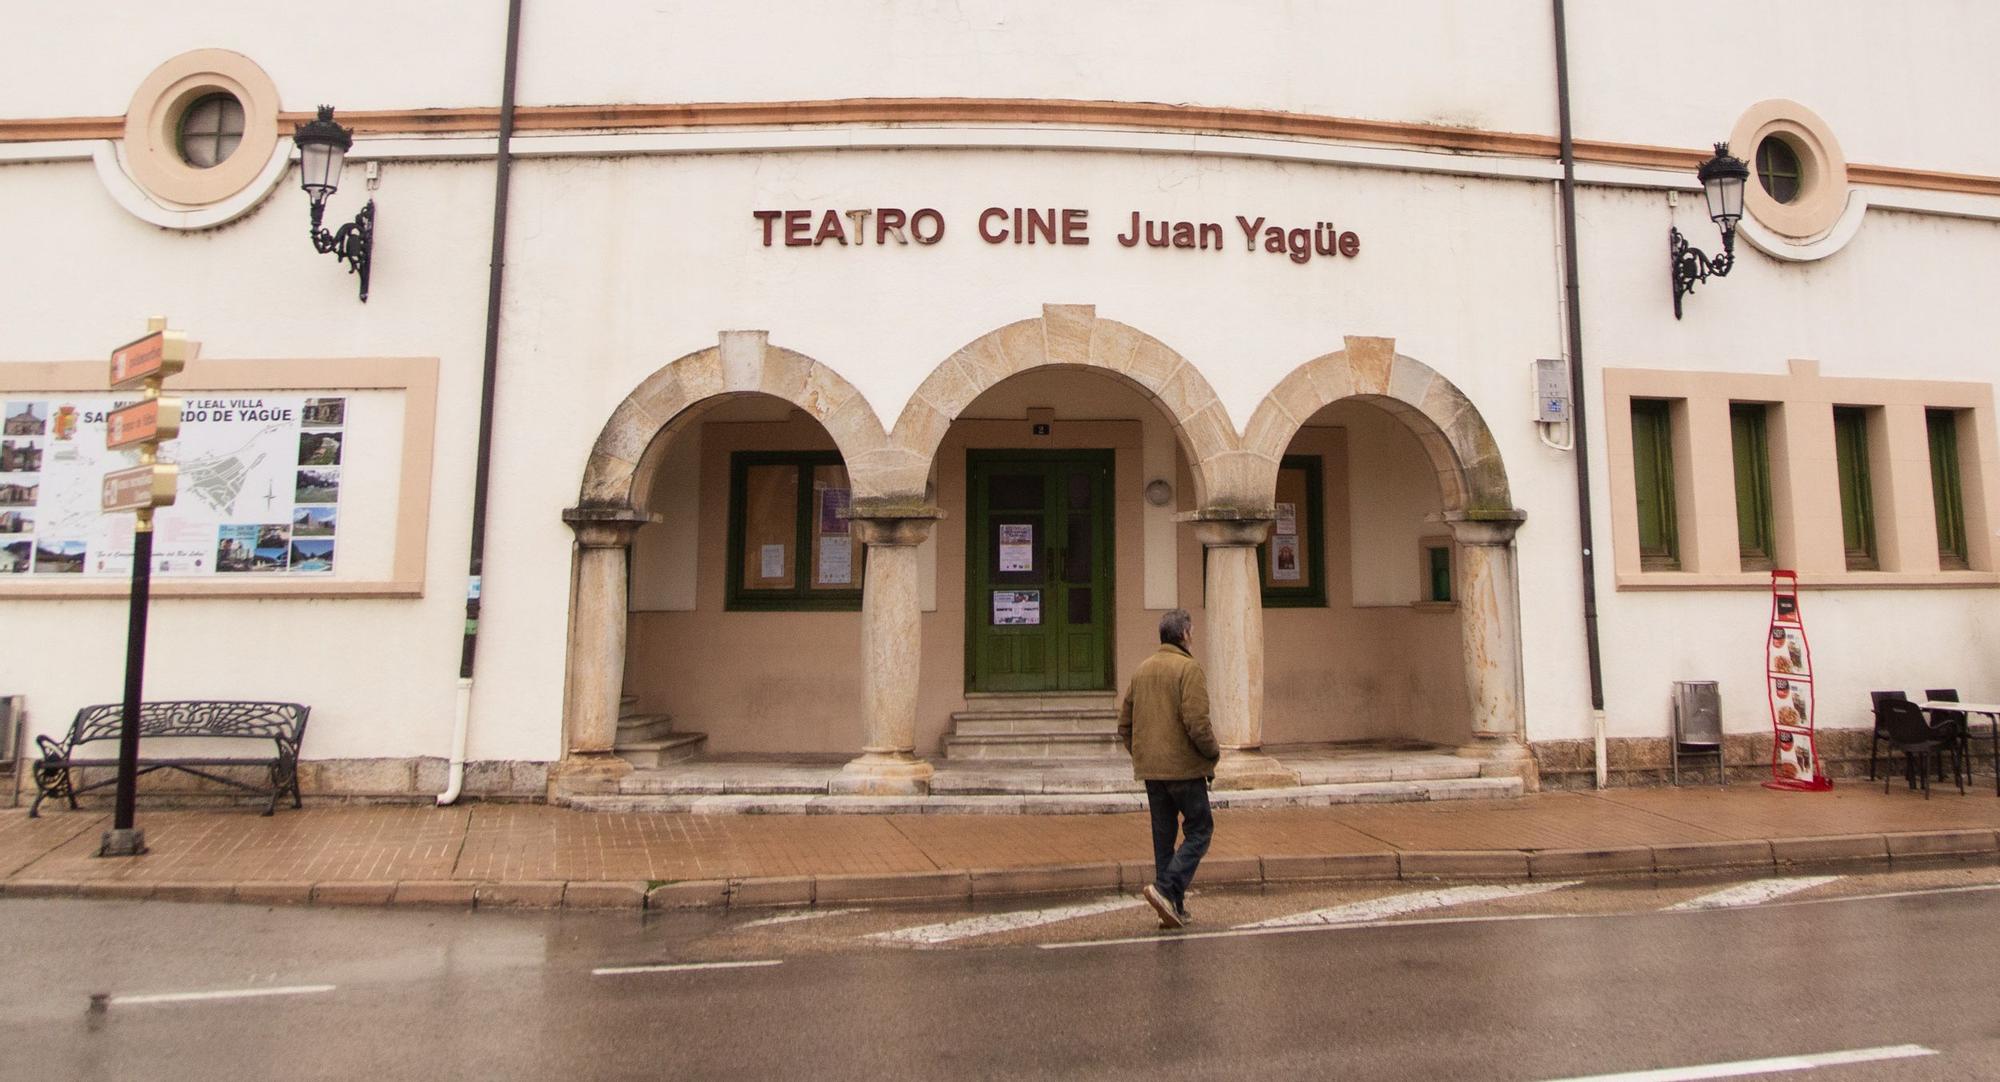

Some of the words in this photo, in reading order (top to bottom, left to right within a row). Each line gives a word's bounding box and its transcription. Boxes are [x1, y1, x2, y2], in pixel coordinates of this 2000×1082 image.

[753, 208, 945, 246] TEATRO
[978, 207, 1090, 245] CINE
[1117, 211, 1223, 252] Juan
[1236, 215, 1361, 264] Yagüe
[186, 400, 194, 409] Y
[197, 400, 226, 409] LEAL
[230, 399, 264, 408] VILLA
[213, 410, 233, 422] DE
[239, 407, 292, 422] YAGÜE
